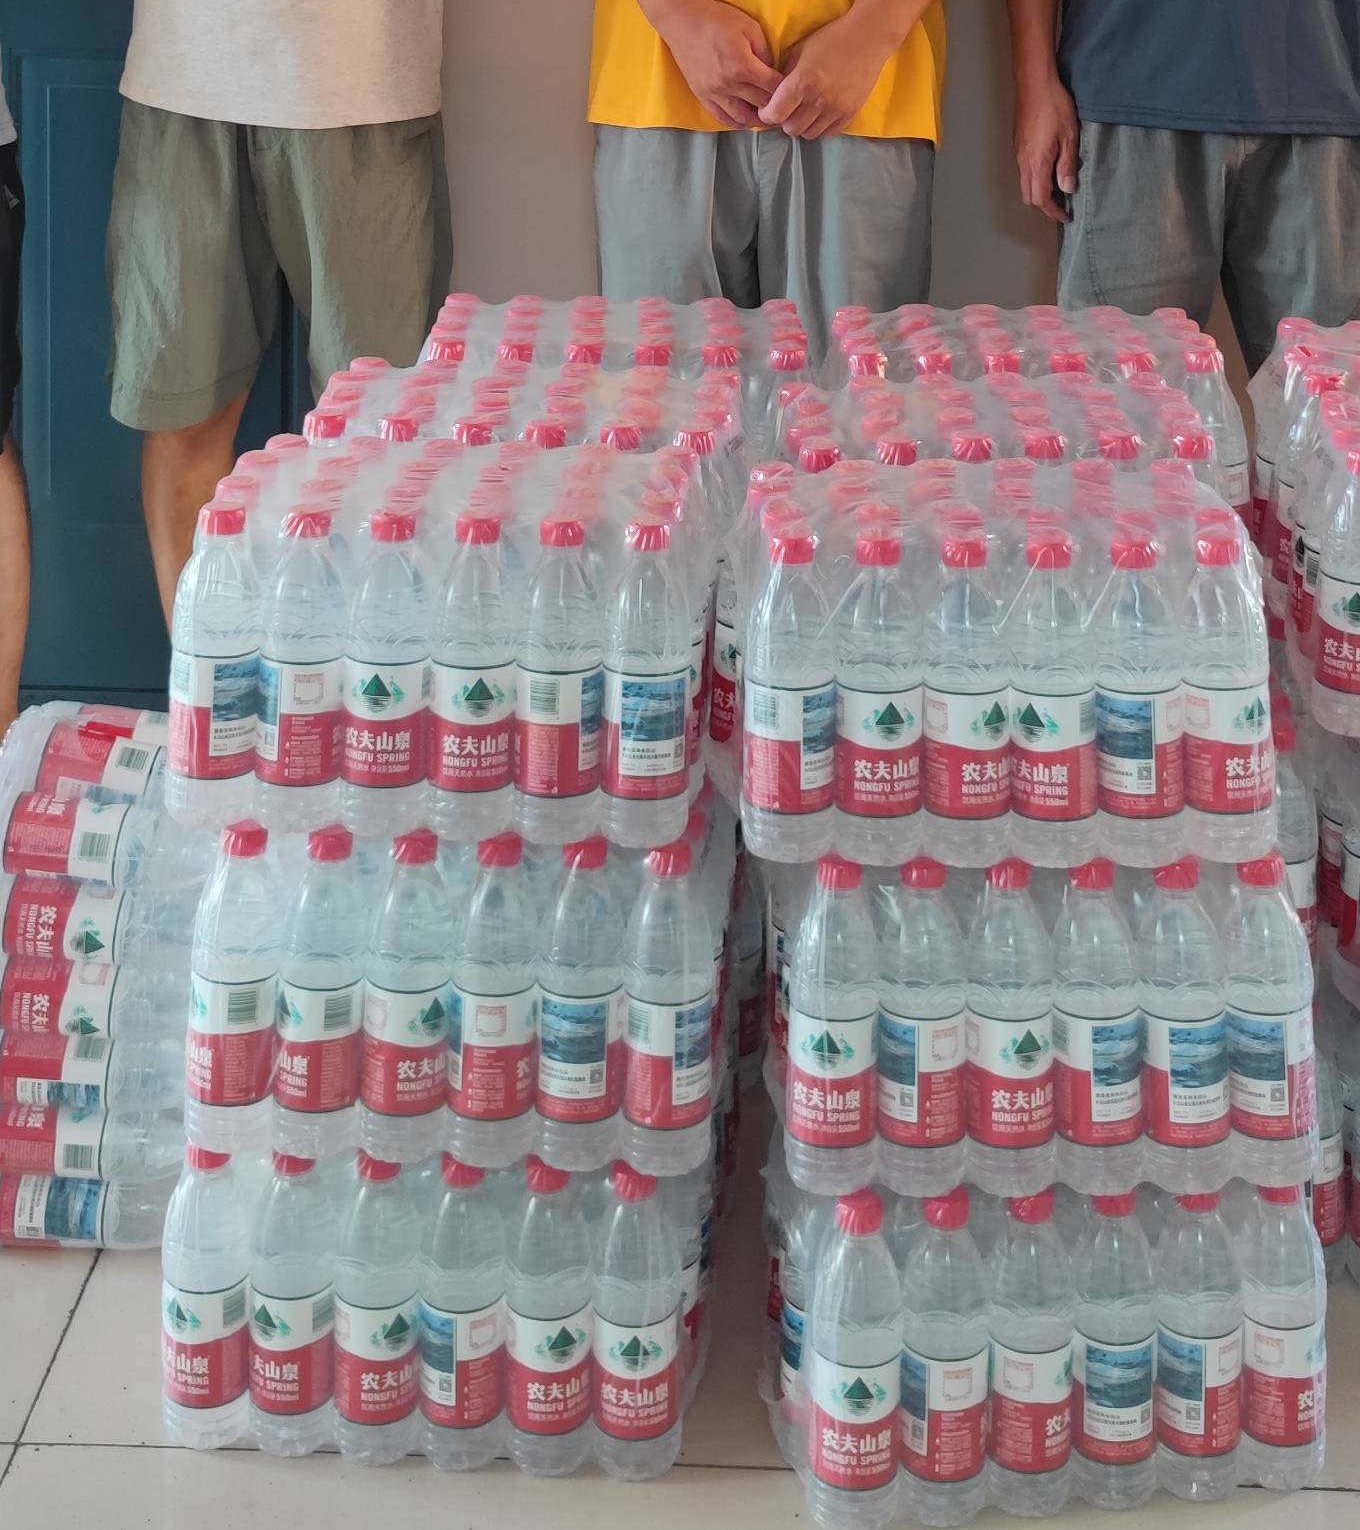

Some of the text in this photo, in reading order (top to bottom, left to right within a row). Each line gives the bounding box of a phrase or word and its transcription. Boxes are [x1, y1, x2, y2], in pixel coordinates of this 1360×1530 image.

[346, 727, 410, 750] 农夫山泉
[442, 732, 508, 755] 农夫山泉
[377, 752, 410, 763] SPRING
[442, 755, 477, 767] NONGFU
[853, 756, 919, 780] 农夫山泉
[853, 780, 890, 792] NONGFU
[961, 780, 997, 794] NONGFU
[1034, 784, 1068, 796] SPRING
[25, 903, 39, 939] NONGFU
[279, 1050, 308, 1075] 山泉
[793, 1081, 860, 1110] 农夫山泉
[827, 1111, 860, 1122] SPRING
[991, 1110, 1029, 1123] NONGFU
[601, 1382, 668, 1407] 农夫山泉
[822, 1427, 890, 1454] 农夫山泉
